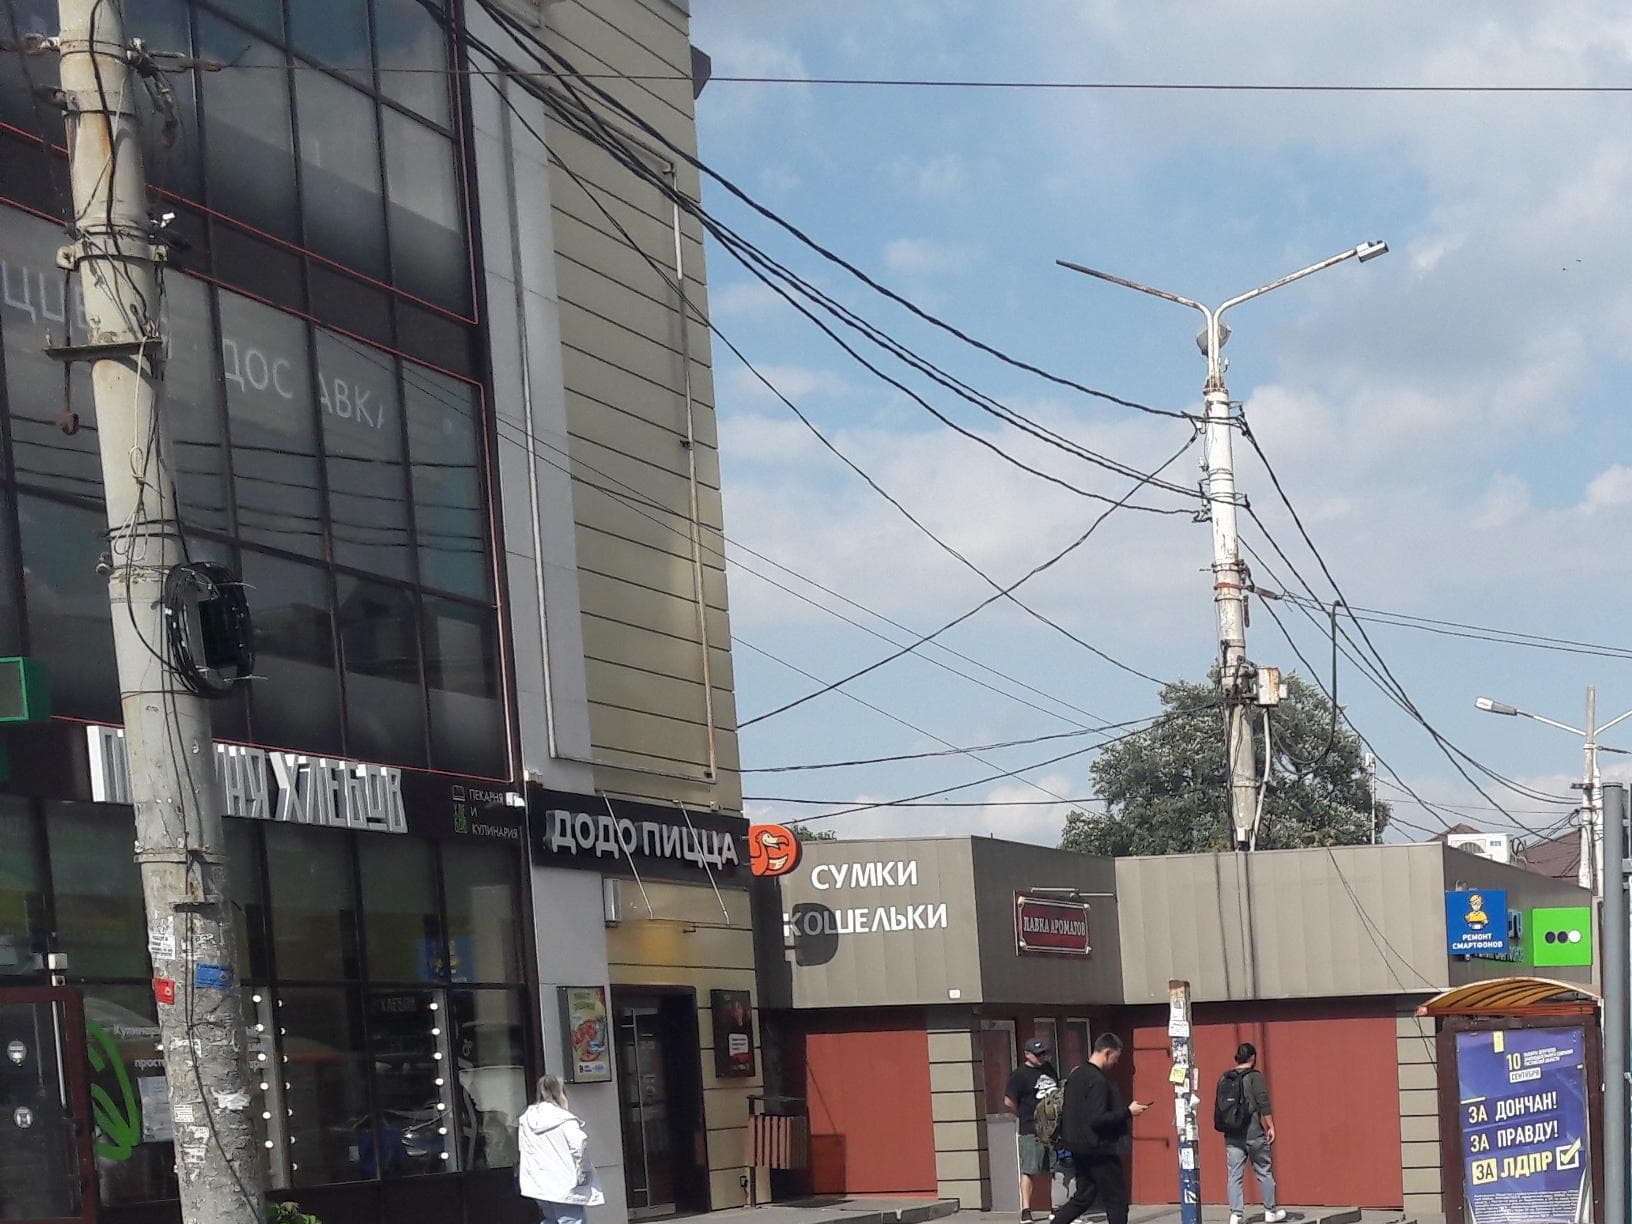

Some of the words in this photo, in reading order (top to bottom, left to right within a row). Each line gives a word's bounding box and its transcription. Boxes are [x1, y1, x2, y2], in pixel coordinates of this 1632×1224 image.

[222, 337, 384, 430] ДОСАВК
[470, 806, 478, 818] И
[472, 823, 518, 839] КУЛИНАРИЯ
[546, 809, 637, 860] ДОДО
[641, 820, 739, 871] ПИЦЦА
[811, 860, 918, 890] СУМКИ
[783, 903, 948, 937] КОШЕЛЬКИ
[1024, 917, 1049, 933] ЛАВКА
[1050, 919, 1086, 936] АРОМАТОВ
[1452, 941, 1503, 950] СМАРТФОНОВ
[1462, 932, 1493, 942] РЕМОНТ
[1506, 1052, 1521, 1071] 10
[1468, 1104, 1488, 1124] ЗА
[1496, 1091, 1557, 1121] ДОНЧАН!
[1470, 1133, 1490, 1153] ЗА
[1497, 1120, 1559, 1147] ПРАВДУ!
[1476, 1161, 1495, 1181] ЗА
[1501, 1151, 1553, 1178] ЛДПР
